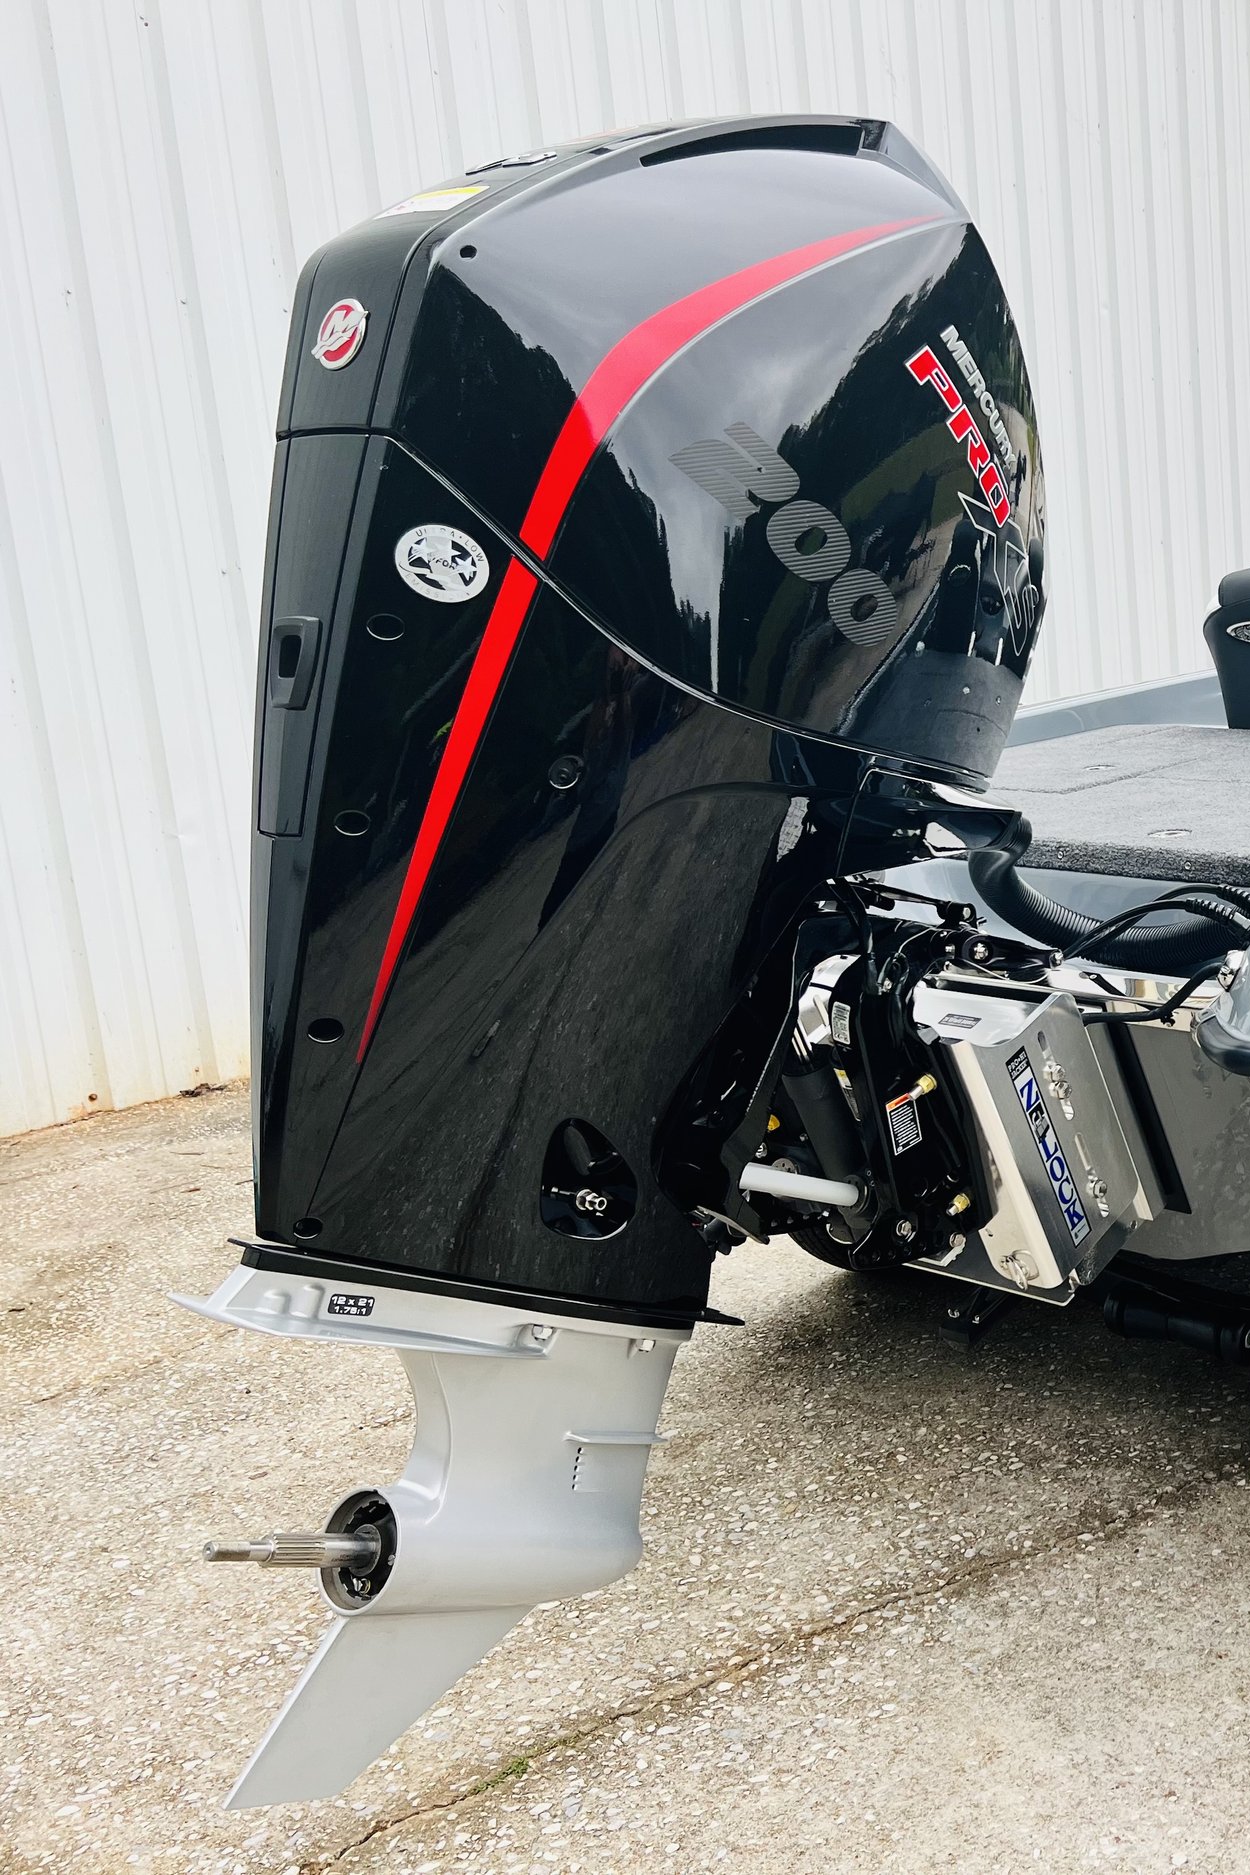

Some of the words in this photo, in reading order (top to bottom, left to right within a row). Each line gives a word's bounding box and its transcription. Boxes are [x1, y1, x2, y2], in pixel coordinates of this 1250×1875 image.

[905, 345, 1010, 527] PRO
[940, 325, 1017, 471] MERCURY
[464, 539, 485, 562] LOW
[668, 421, 898, 647] 200
[332, 1296, 346, 1305] 12
[358, 1298, 374, 1307] 21
[334, 1306, 366, 1315] 1.75:1
